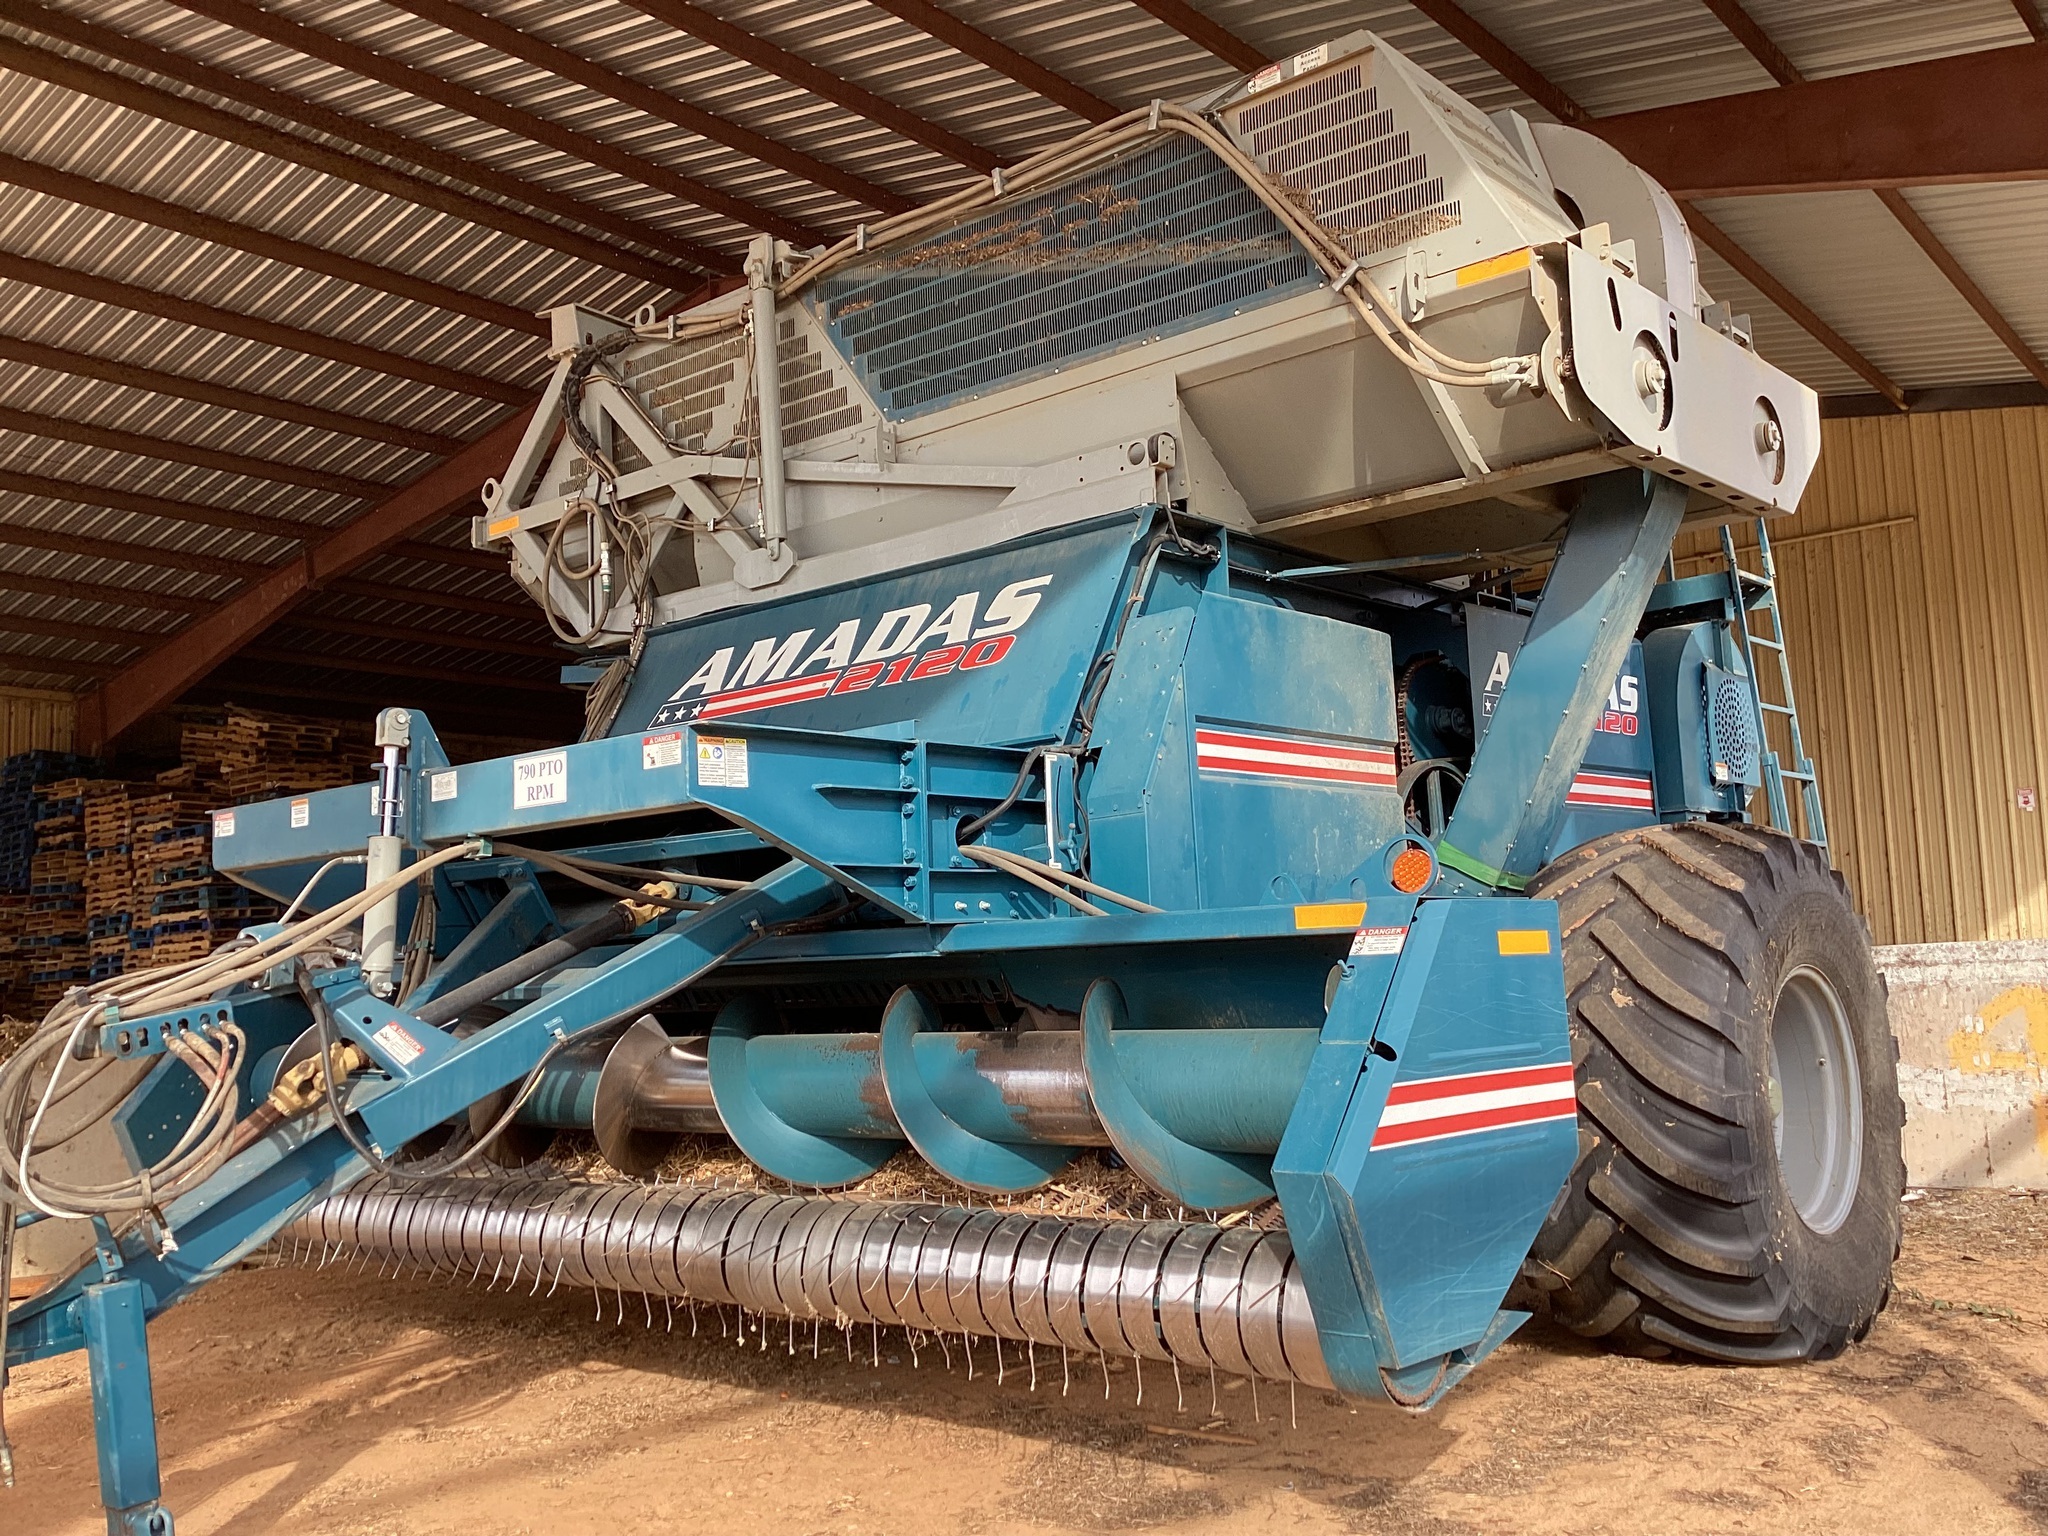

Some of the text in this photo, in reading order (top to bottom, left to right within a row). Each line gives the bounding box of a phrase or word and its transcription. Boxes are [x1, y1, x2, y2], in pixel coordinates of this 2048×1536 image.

[668, 574, 1054, 702] AMADAS
[832, 634, 1017, 696] 2120
[654, 733, 676, 744] DANGER
[518, 759, 563, 780] 790 PTO
[527, 783, 554, 801] RPM
[1368, 927, 1403, 935] DANGER
[396, 1028, 421, 1051] DANGER
